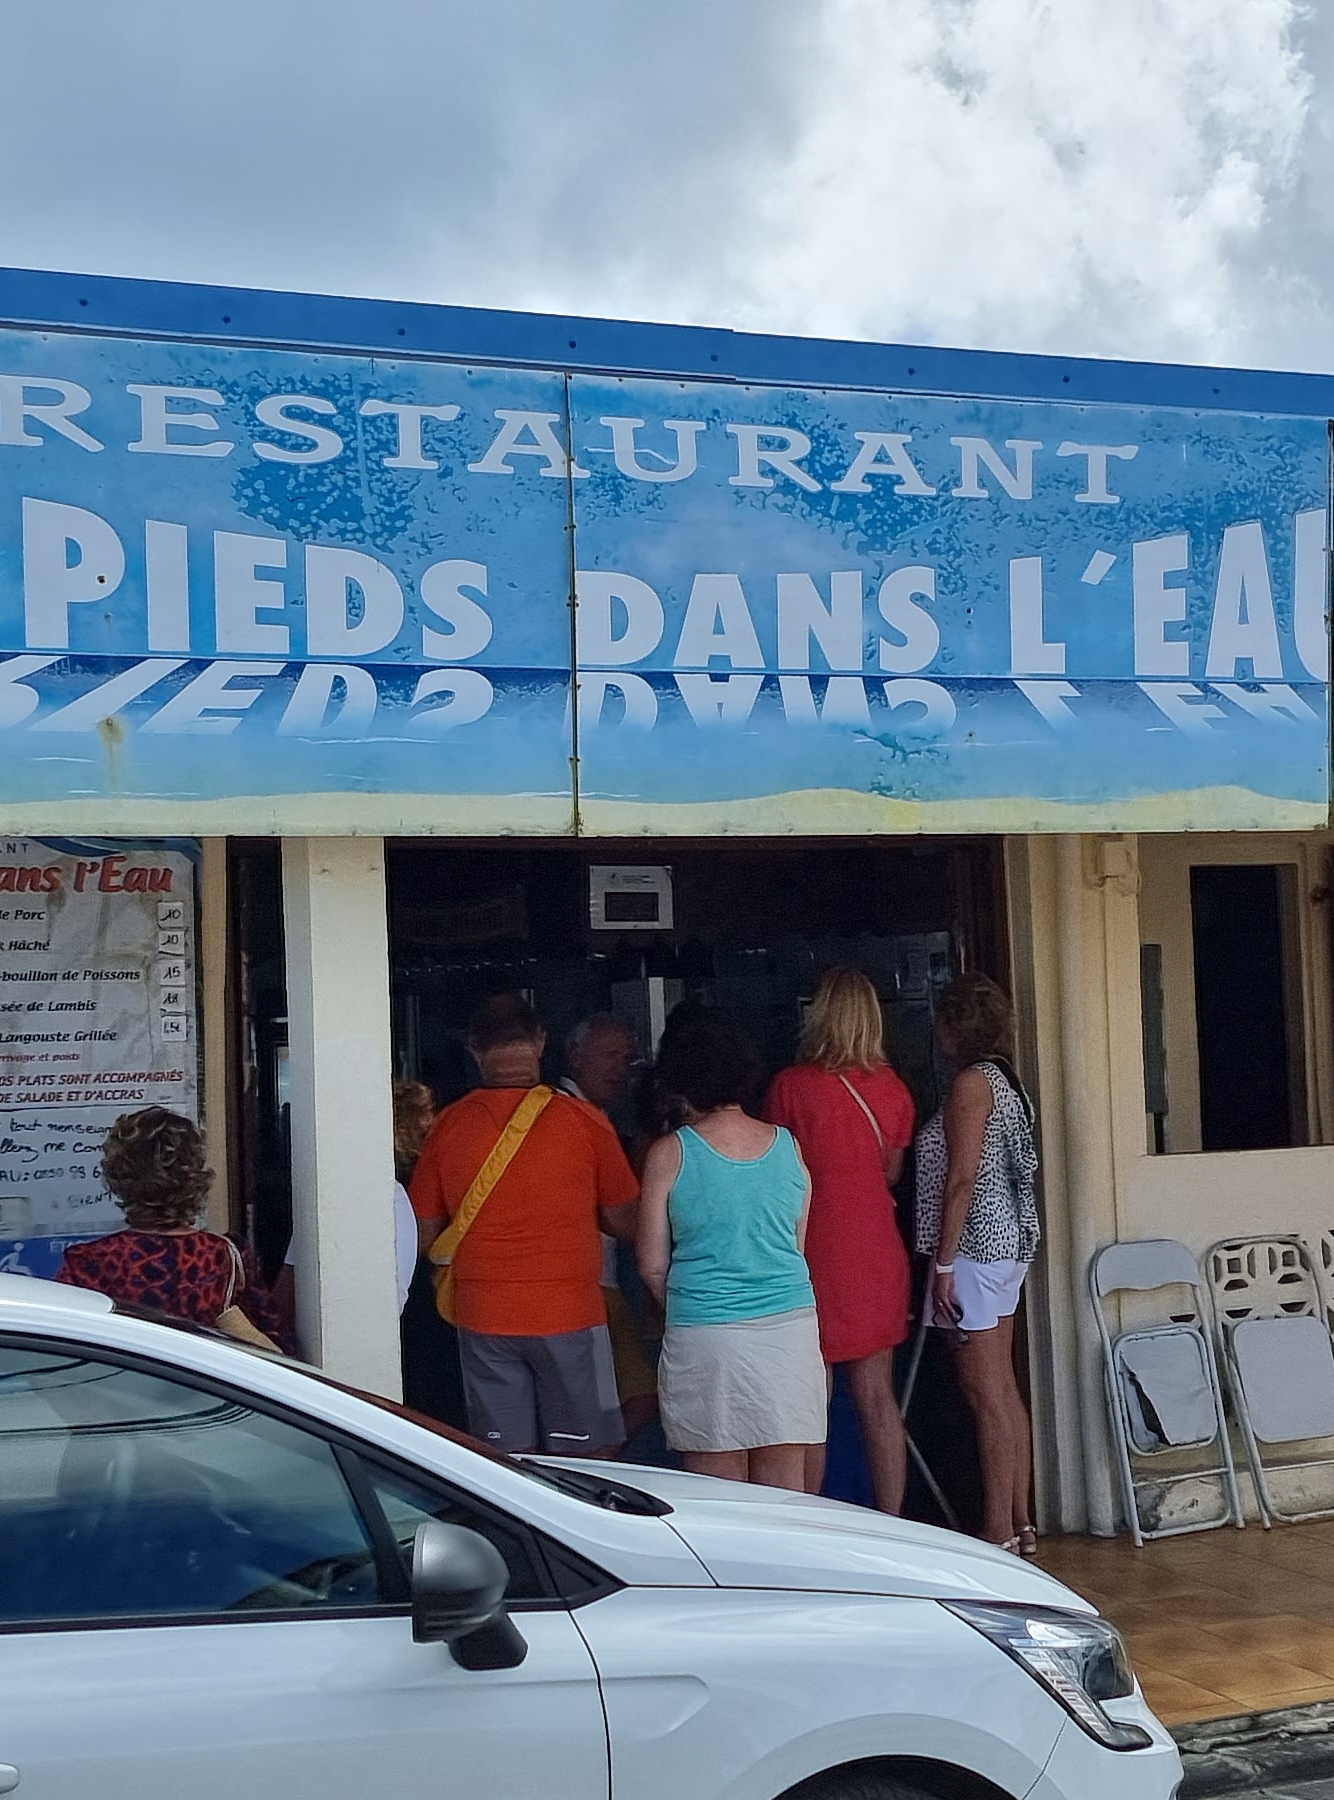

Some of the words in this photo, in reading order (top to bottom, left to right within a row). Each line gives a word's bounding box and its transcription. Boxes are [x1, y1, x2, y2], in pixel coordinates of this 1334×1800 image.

[22, 496, 494, 661] PIEDS
[575, 566, 940, 674] DANS
[73, 855, 174, 893] l'Eau
[14, 909, 46, 921] Porc
[61, 970, 79, 981] de
[83, 969, 141, 982] Poissons
[163, 966, 181, 980] 15
[26, 1001, 44, 1013] de
[48, 1000, 97, 1012] Lambis
[74, 1030, 117, 1043] Grillée
[17, 1073, 55, 1087] PLATS
[58, 1072, 90, 1086] SONT
[93, 1068, 184, 1085] ACCOMPAGNÉS
[16, 1091, 64, 1104] SALADE
[67, 1090, 83, 1102] ET
[84, 1088, 144, 1101] D'ACCRAS
